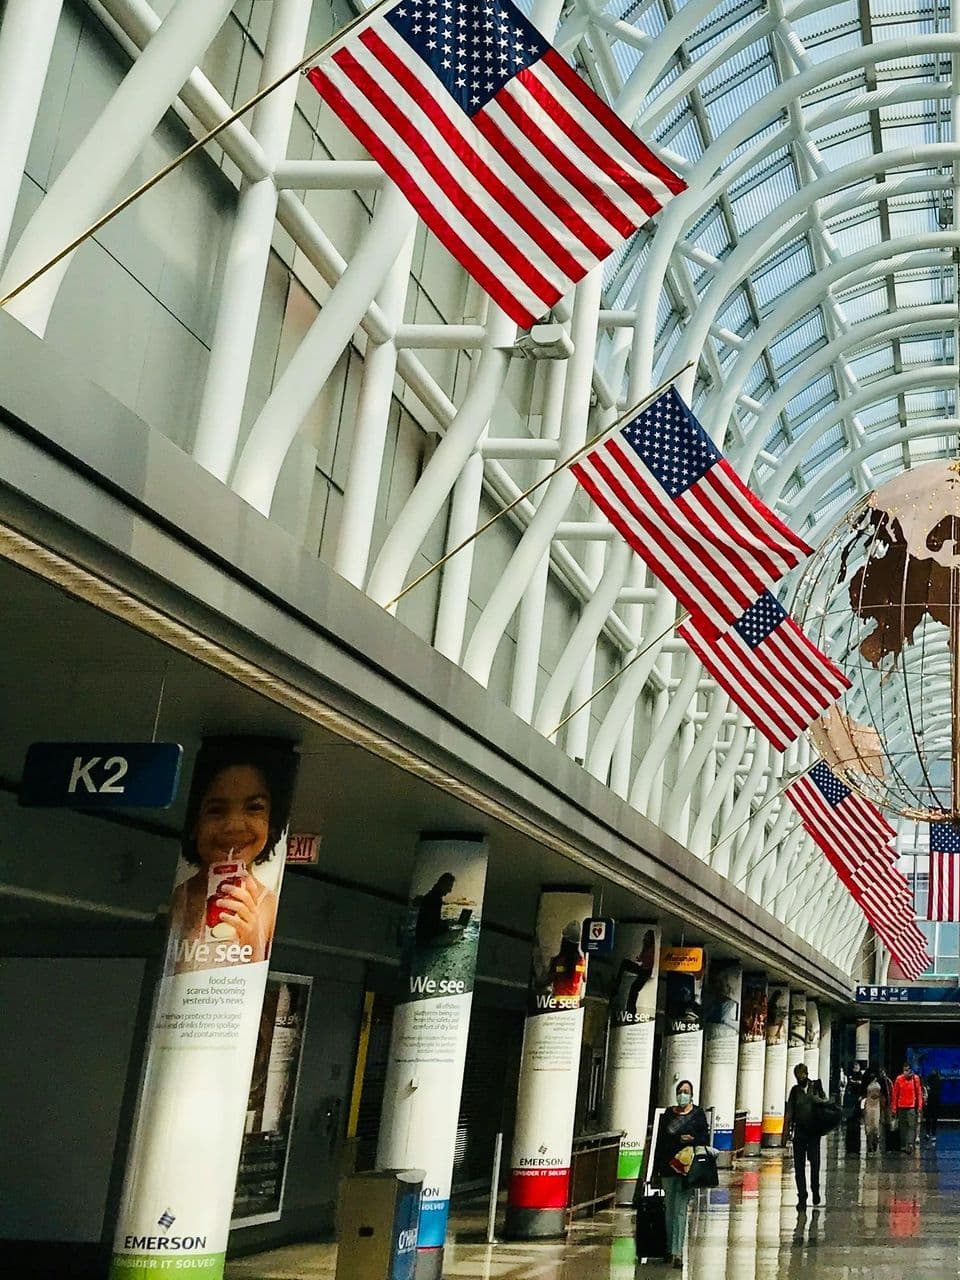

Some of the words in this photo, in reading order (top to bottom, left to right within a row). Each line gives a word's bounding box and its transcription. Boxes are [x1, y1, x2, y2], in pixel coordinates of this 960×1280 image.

[68, 756, 129, 793] K2
[287, 837, 315, 857] EXIT
[175, 939, 210, 962] We
[214, 943, 253, 963] see
[208, 976, 227, 985] food
[227, 976, 246, 987] safety
[409, 976, 437, 993] We
[439, 980, 465, 994] see
[210, 987, 246, 996] becoming
[182, 997, 225, 1006] yesterday's
[537, 995, 558, 1009] We
[559, 998, 580, 1009] see
[671, 1021, 686, 1031] We
[687, 1022, 701, 1031] see
[520, 1158, 563, 1166] EMERSON
[421, 1187, 440, 1198] ON
[124, 1235, 207, 1250] EMERSON
[160, 1260, 172, 1269] IT
[175, 1258, 216, 1270] SOLVED
